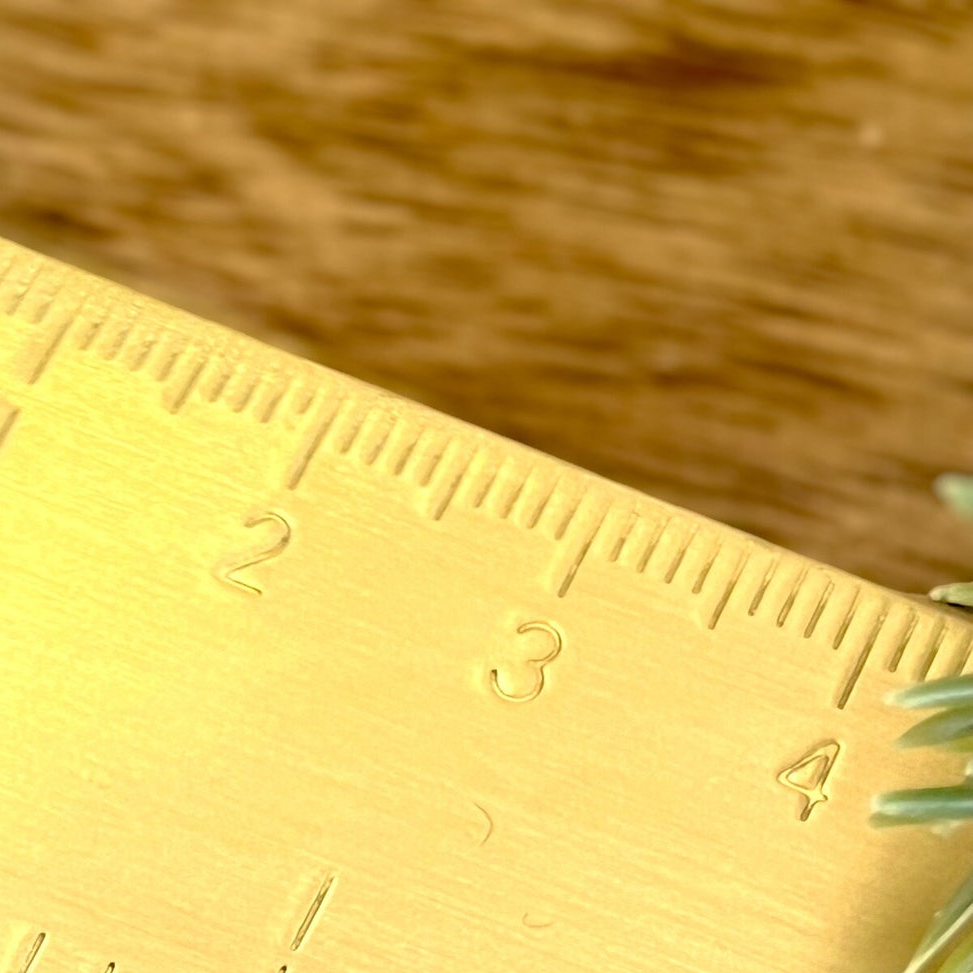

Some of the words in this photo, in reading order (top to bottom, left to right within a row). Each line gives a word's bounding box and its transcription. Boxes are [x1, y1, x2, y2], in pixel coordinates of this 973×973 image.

[214, 510, 293, 596] 2
[489, 620, 563, 702] 3
[777, 738, 842, 822] 4
